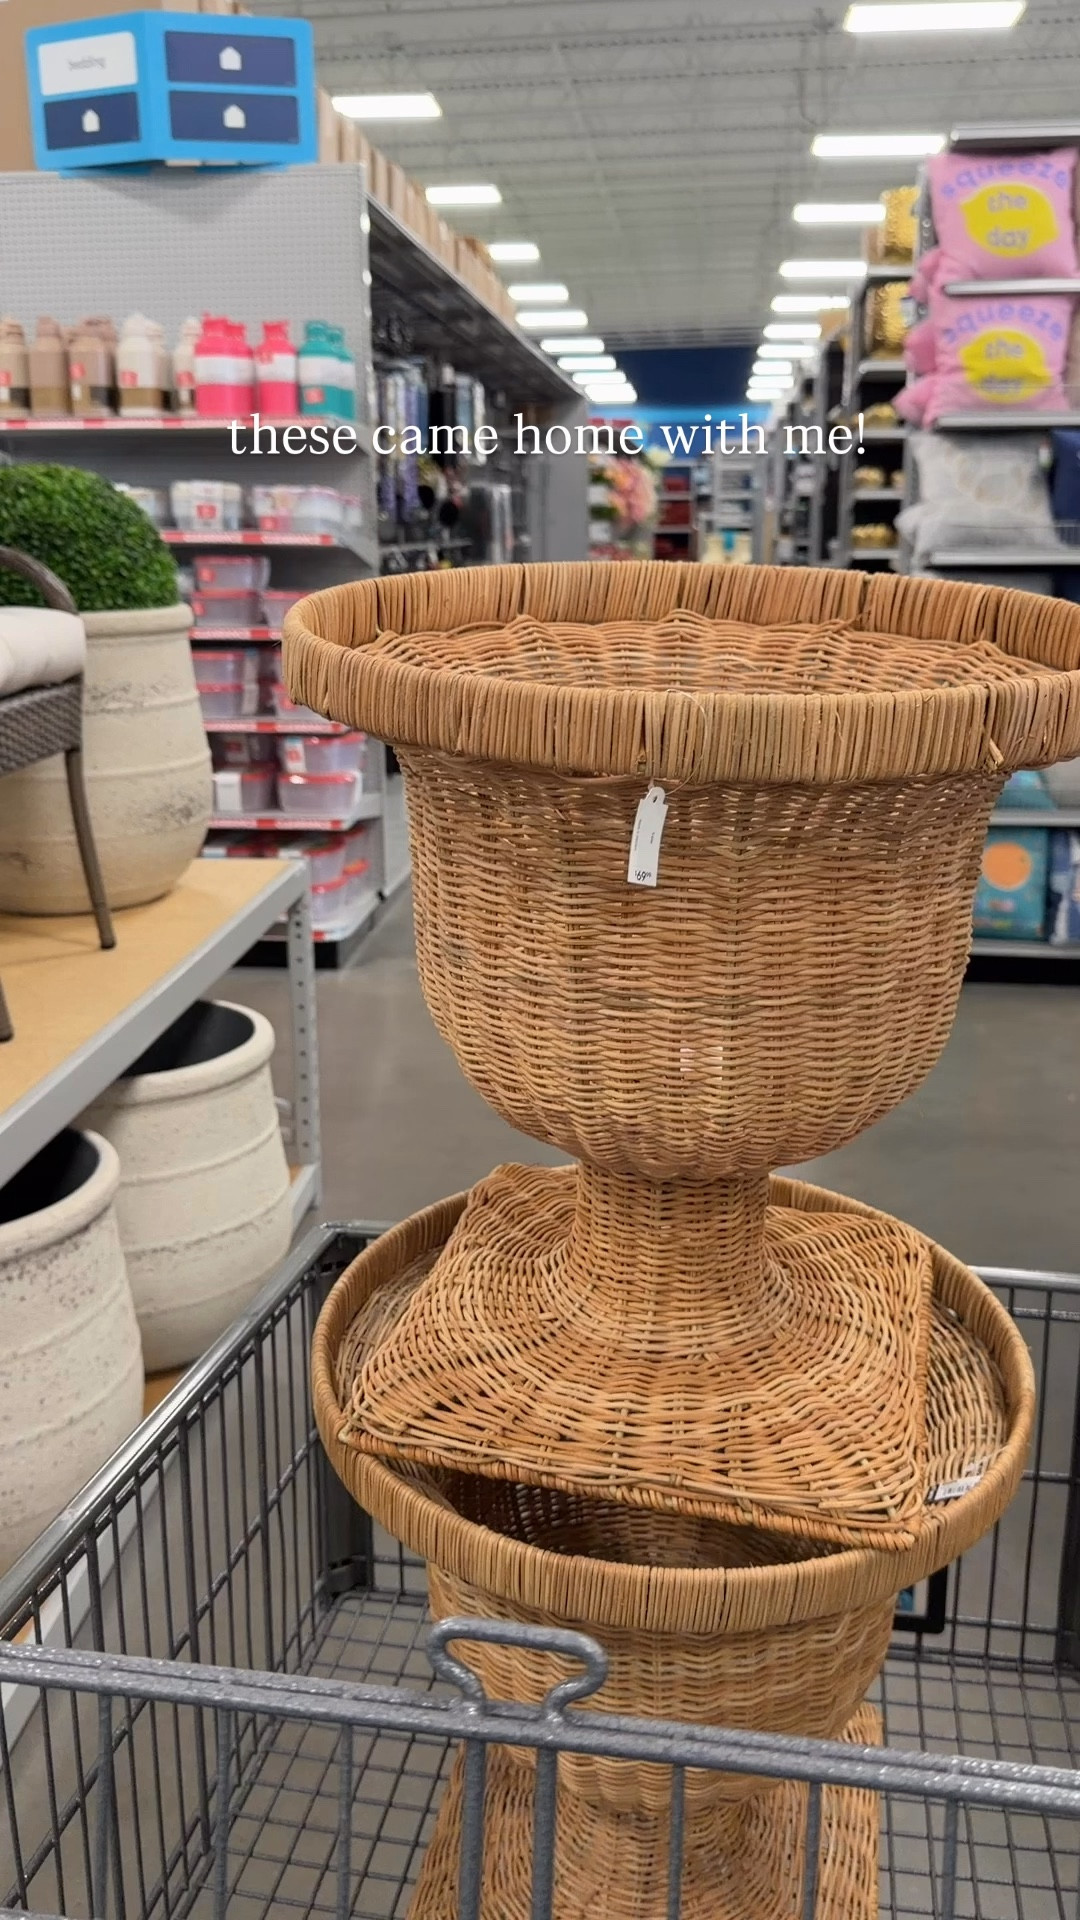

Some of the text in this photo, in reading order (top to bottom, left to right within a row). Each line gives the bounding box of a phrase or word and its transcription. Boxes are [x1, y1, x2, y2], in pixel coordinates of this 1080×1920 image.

[941, 161, 1069, 200] squeeze
[986, 191, 1028, 213] the
[986, 226, 1031, 250] day
[943, 304, 1063, 343] squeeze
[984, 338, 1025, 361] the
